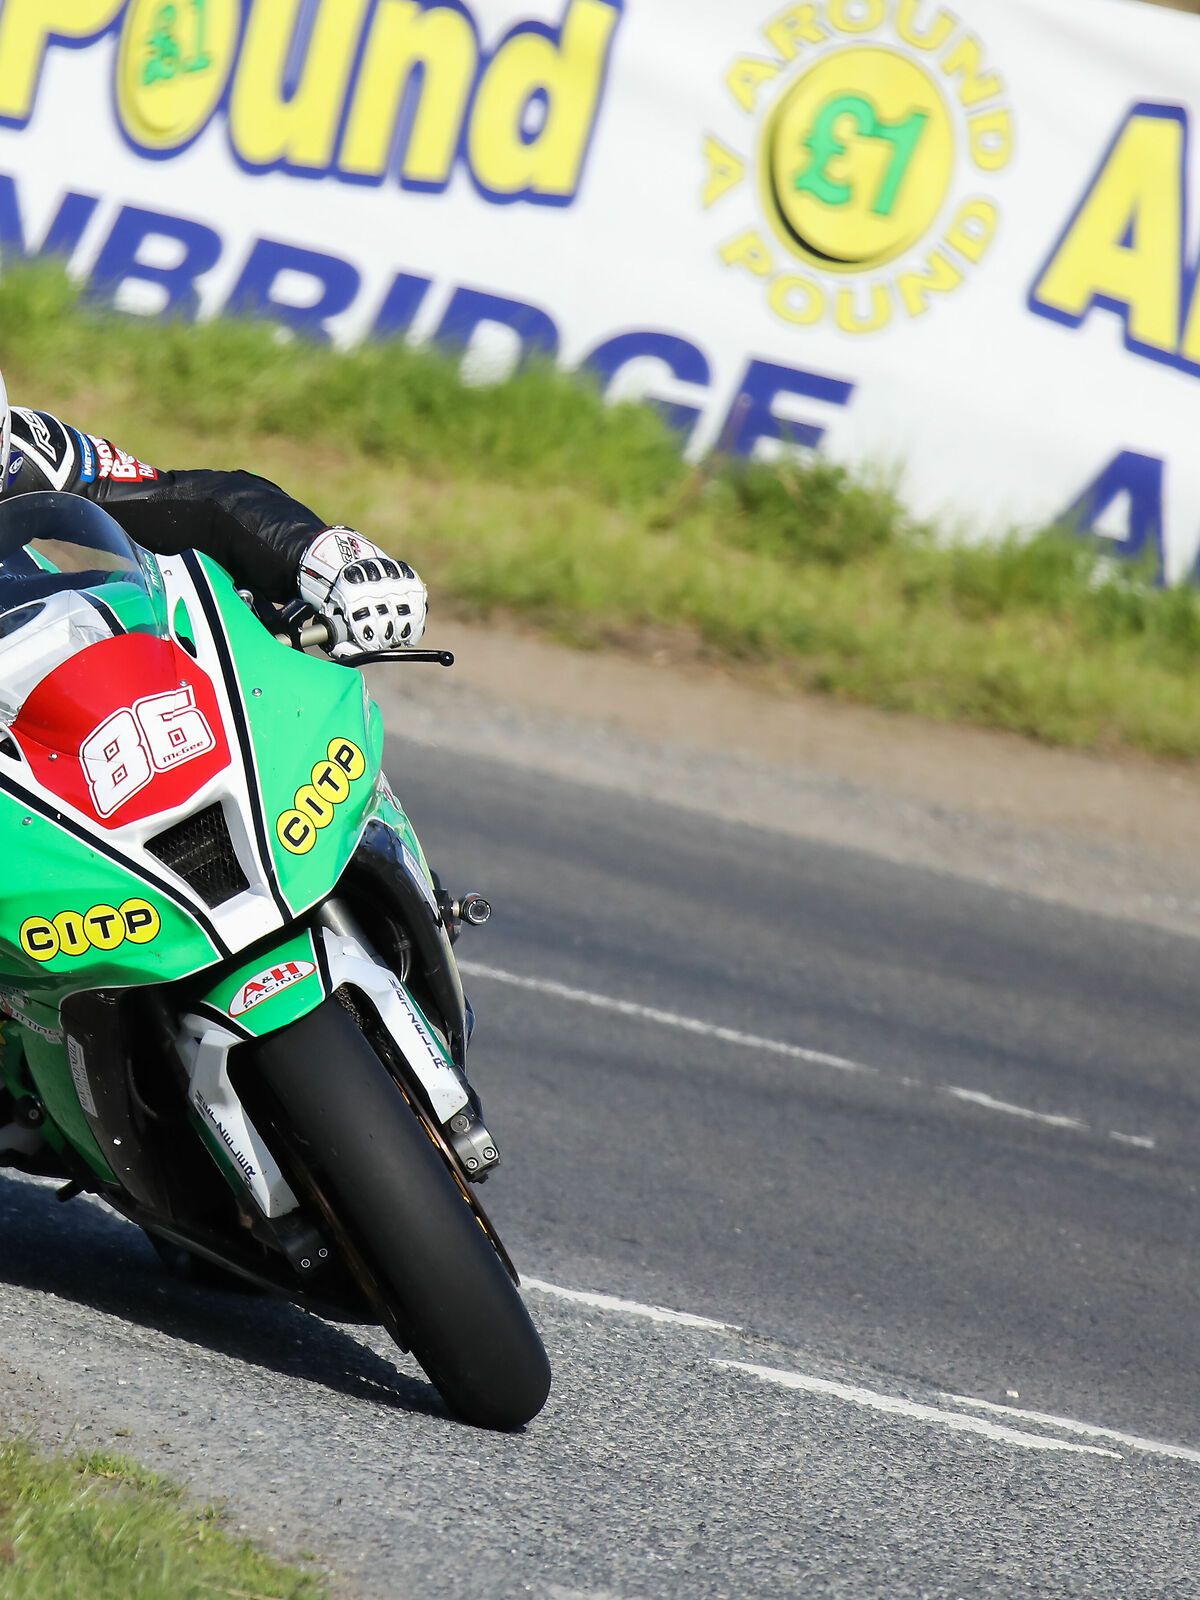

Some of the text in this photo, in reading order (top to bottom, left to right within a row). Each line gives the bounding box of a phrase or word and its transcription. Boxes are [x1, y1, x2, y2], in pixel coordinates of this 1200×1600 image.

[723, 0, 1010, 172] AROUND
[793, 93, 928, 217] £1
[716, 197, 998, 335] POUND
[1027, 102, 1200, 382] A
[78, 684, 217, 819] 86
[162, 739, 204, 763] McGee
[283, 743, 355, 848] CITP
[26, 907, 153, 951] CITP
[243, 972, 304, 1009] RACING
